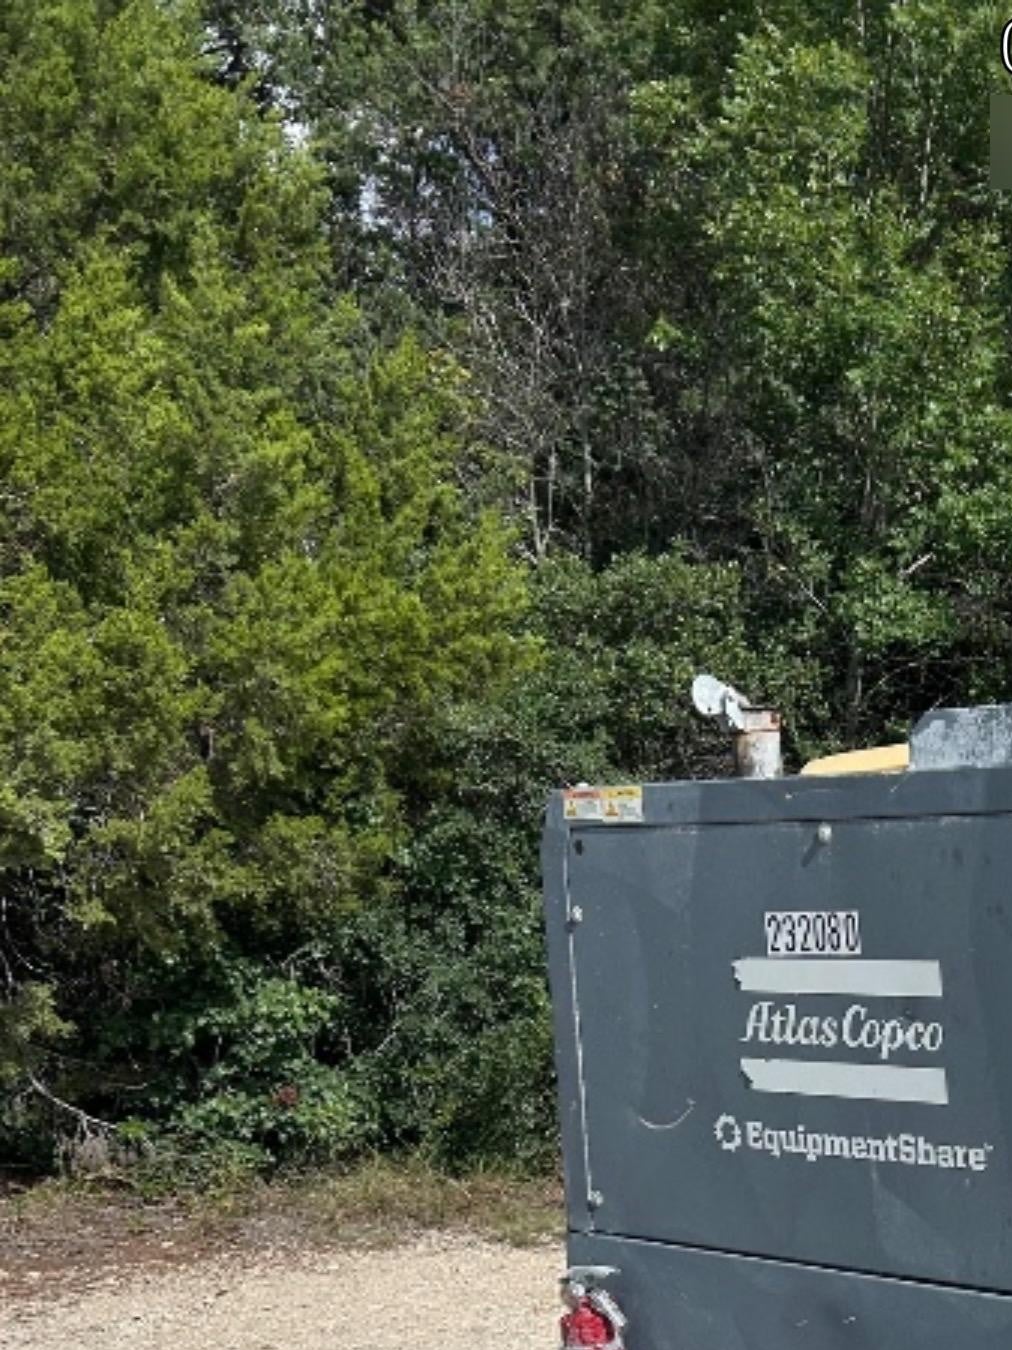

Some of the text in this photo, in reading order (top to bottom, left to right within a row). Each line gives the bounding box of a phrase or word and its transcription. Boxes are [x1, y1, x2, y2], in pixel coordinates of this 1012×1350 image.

[766, 912, 859, 953] 232080
[739, 1001, 943, 1060] Atlas Copco
[746, 1120, 990, 1171] EquipmentShare
